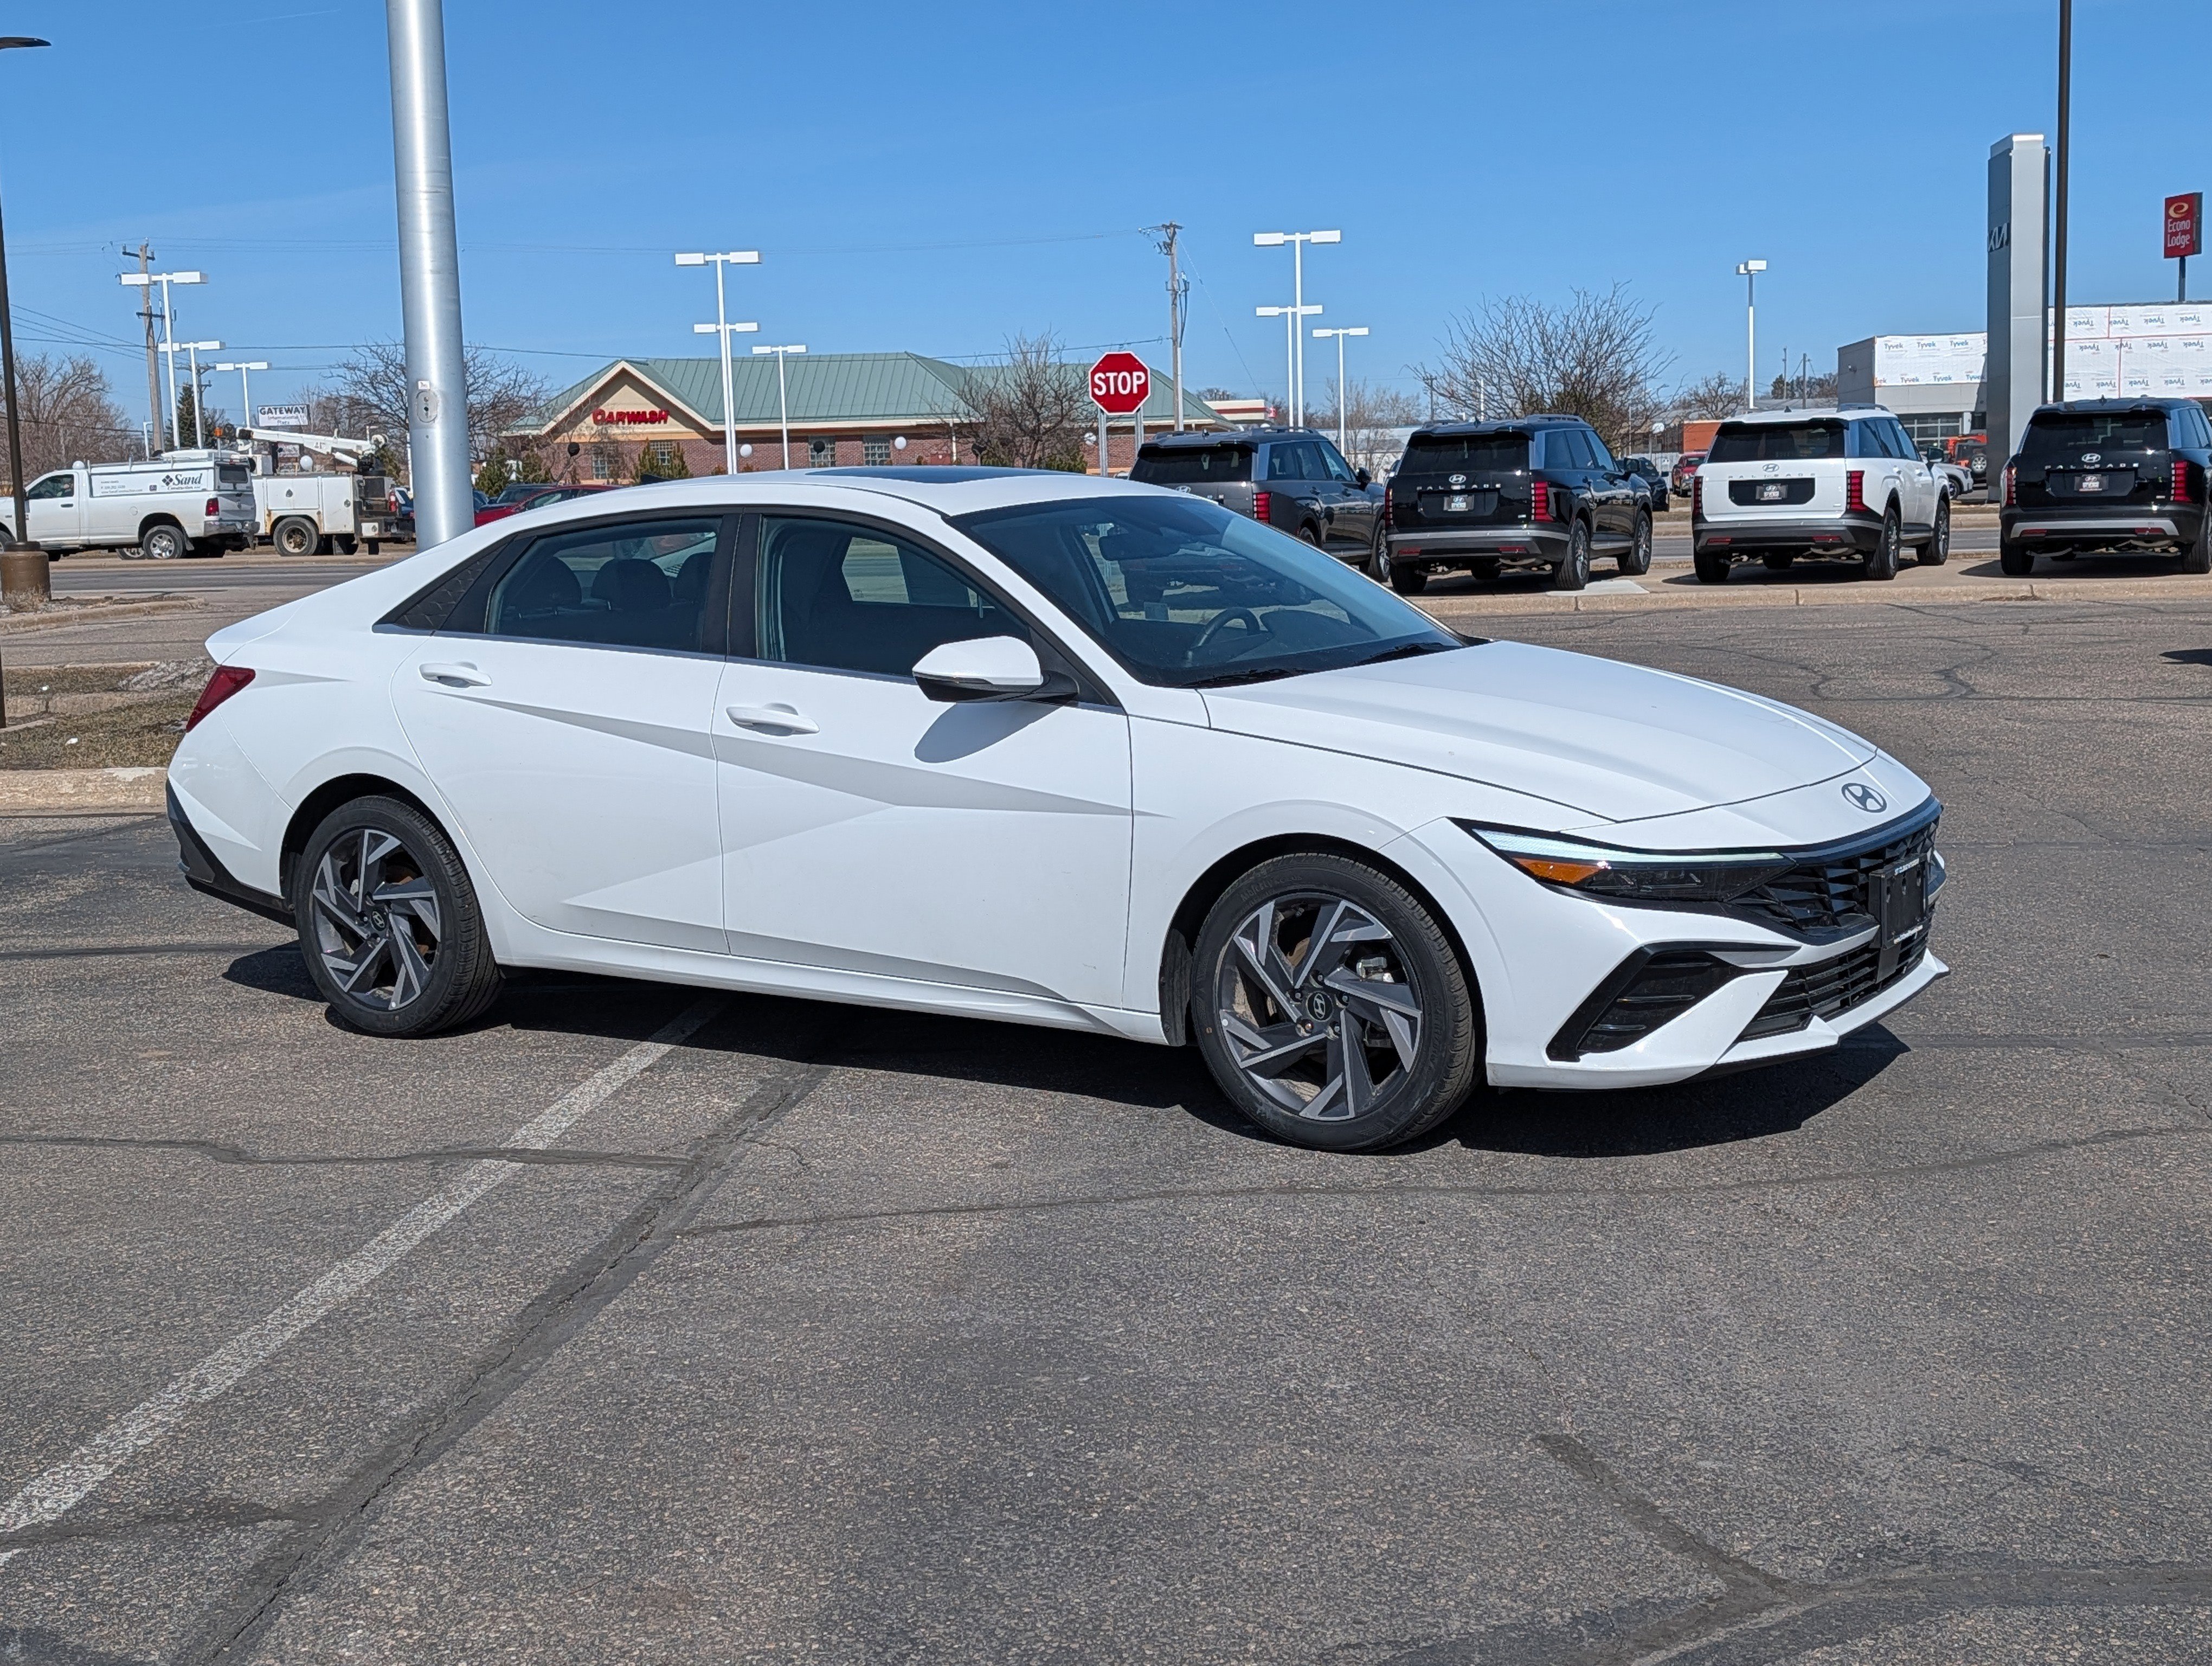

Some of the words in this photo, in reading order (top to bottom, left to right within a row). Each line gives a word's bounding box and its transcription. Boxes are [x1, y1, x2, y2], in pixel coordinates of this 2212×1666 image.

[2168, 219, 2191, 233] Econo
[2167, 232, 2191, 248] Lodge
[1093, 371, 1146, 395] STOP
[260, 406, 305, 415] GATEWAY
[593, 409, 670, 425] CARWASH
[172, 473, 202, 486] Sand
